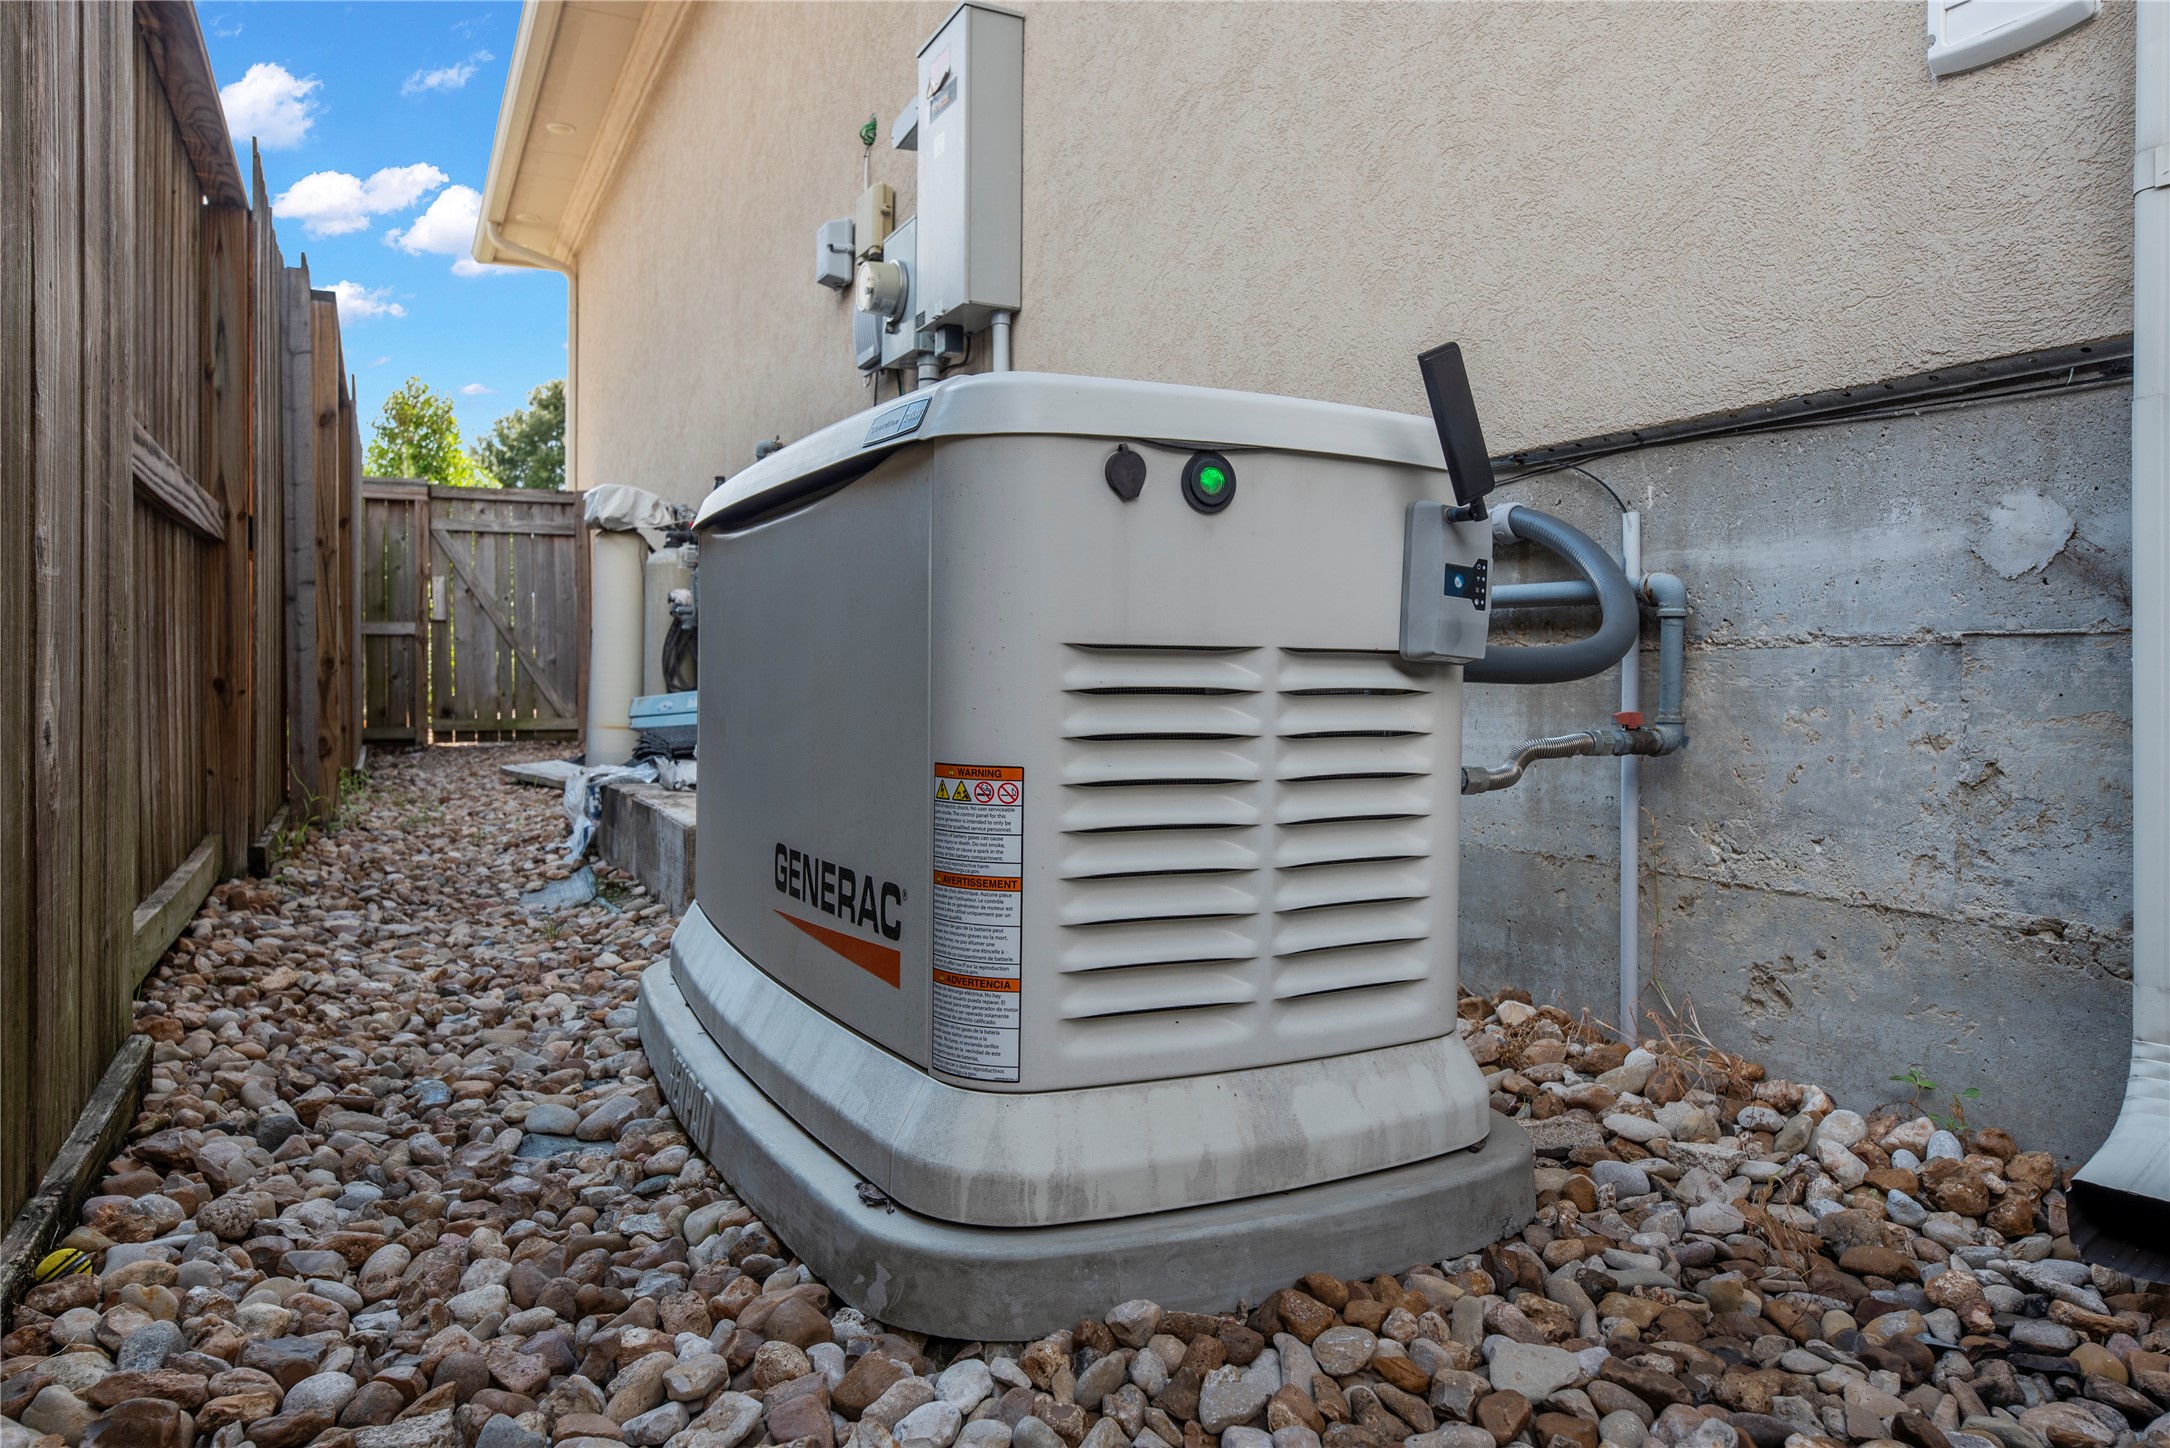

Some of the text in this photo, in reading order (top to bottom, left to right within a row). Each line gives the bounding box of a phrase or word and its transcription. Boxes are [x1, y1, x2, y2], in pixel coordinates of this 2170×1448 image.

[958, 768, 1002, 778] WARNING
[943, 876, 1018, 888] AVERTISSEMENT
[774, 842, 901, 941] GENERAC
[946, 975, 1011, 989] ADVERTENCIA
